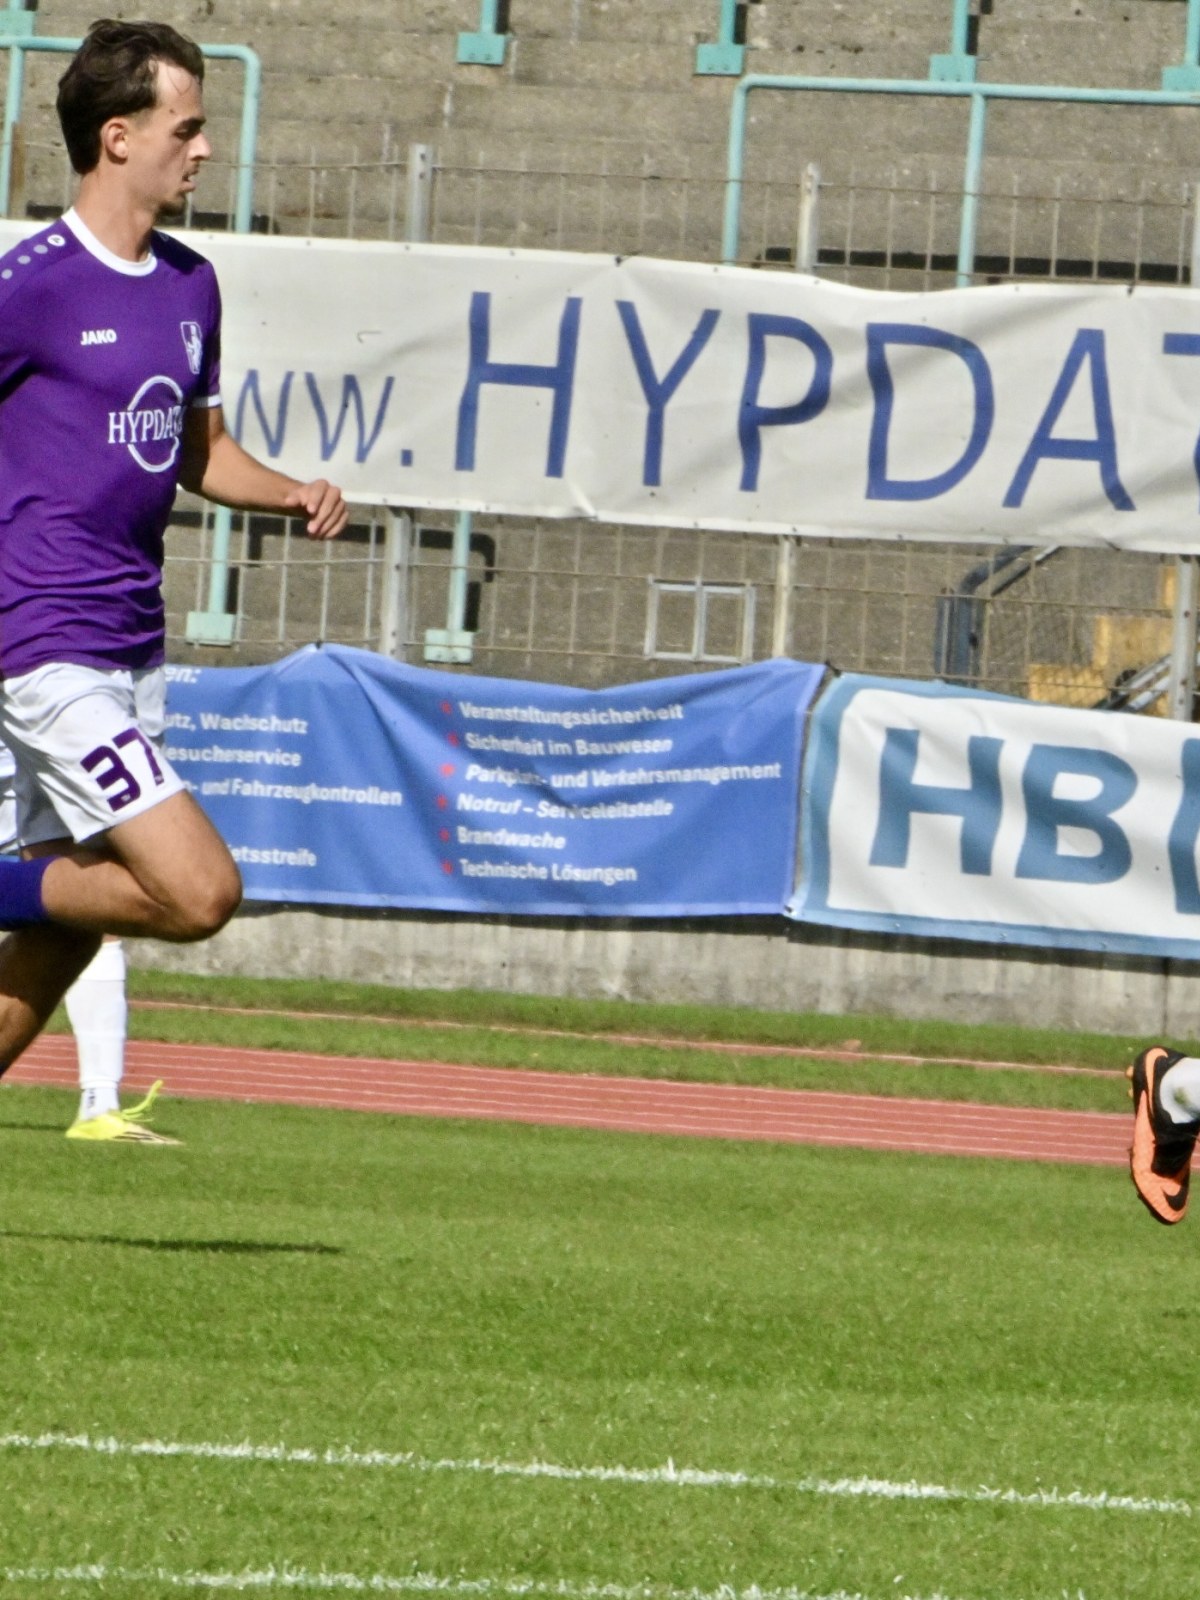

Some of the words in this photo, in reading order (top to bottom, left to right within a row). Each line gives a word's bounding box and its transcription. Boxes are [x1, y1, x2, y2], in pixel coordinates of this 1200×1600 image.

[80, 329, 117, 345] JAKO
[459, 701, 684, 729] Veranstaltungssicherheit
[465, 731, 545, 756] Sicherheit
[548, 739, 572, 755] im
[575, 738, 673, 755] Bauwesen
[81, 727, 166, 812] 37
[551, 769, 588, 788] und
[592, 763, 781, 785] Verkehrsmanagement
[202, 779, 229, 795] und
[231, 778, 402, 806] Fahrzeugkontrollen
[457, 793, 522, 815] Notruf
[457, 826, 566, 850] Brandwache
[230, 845, 318, 867] etsstreife
[459, 858, 548, 879] Technische
[552, 863, 638, 886] Lösungen
